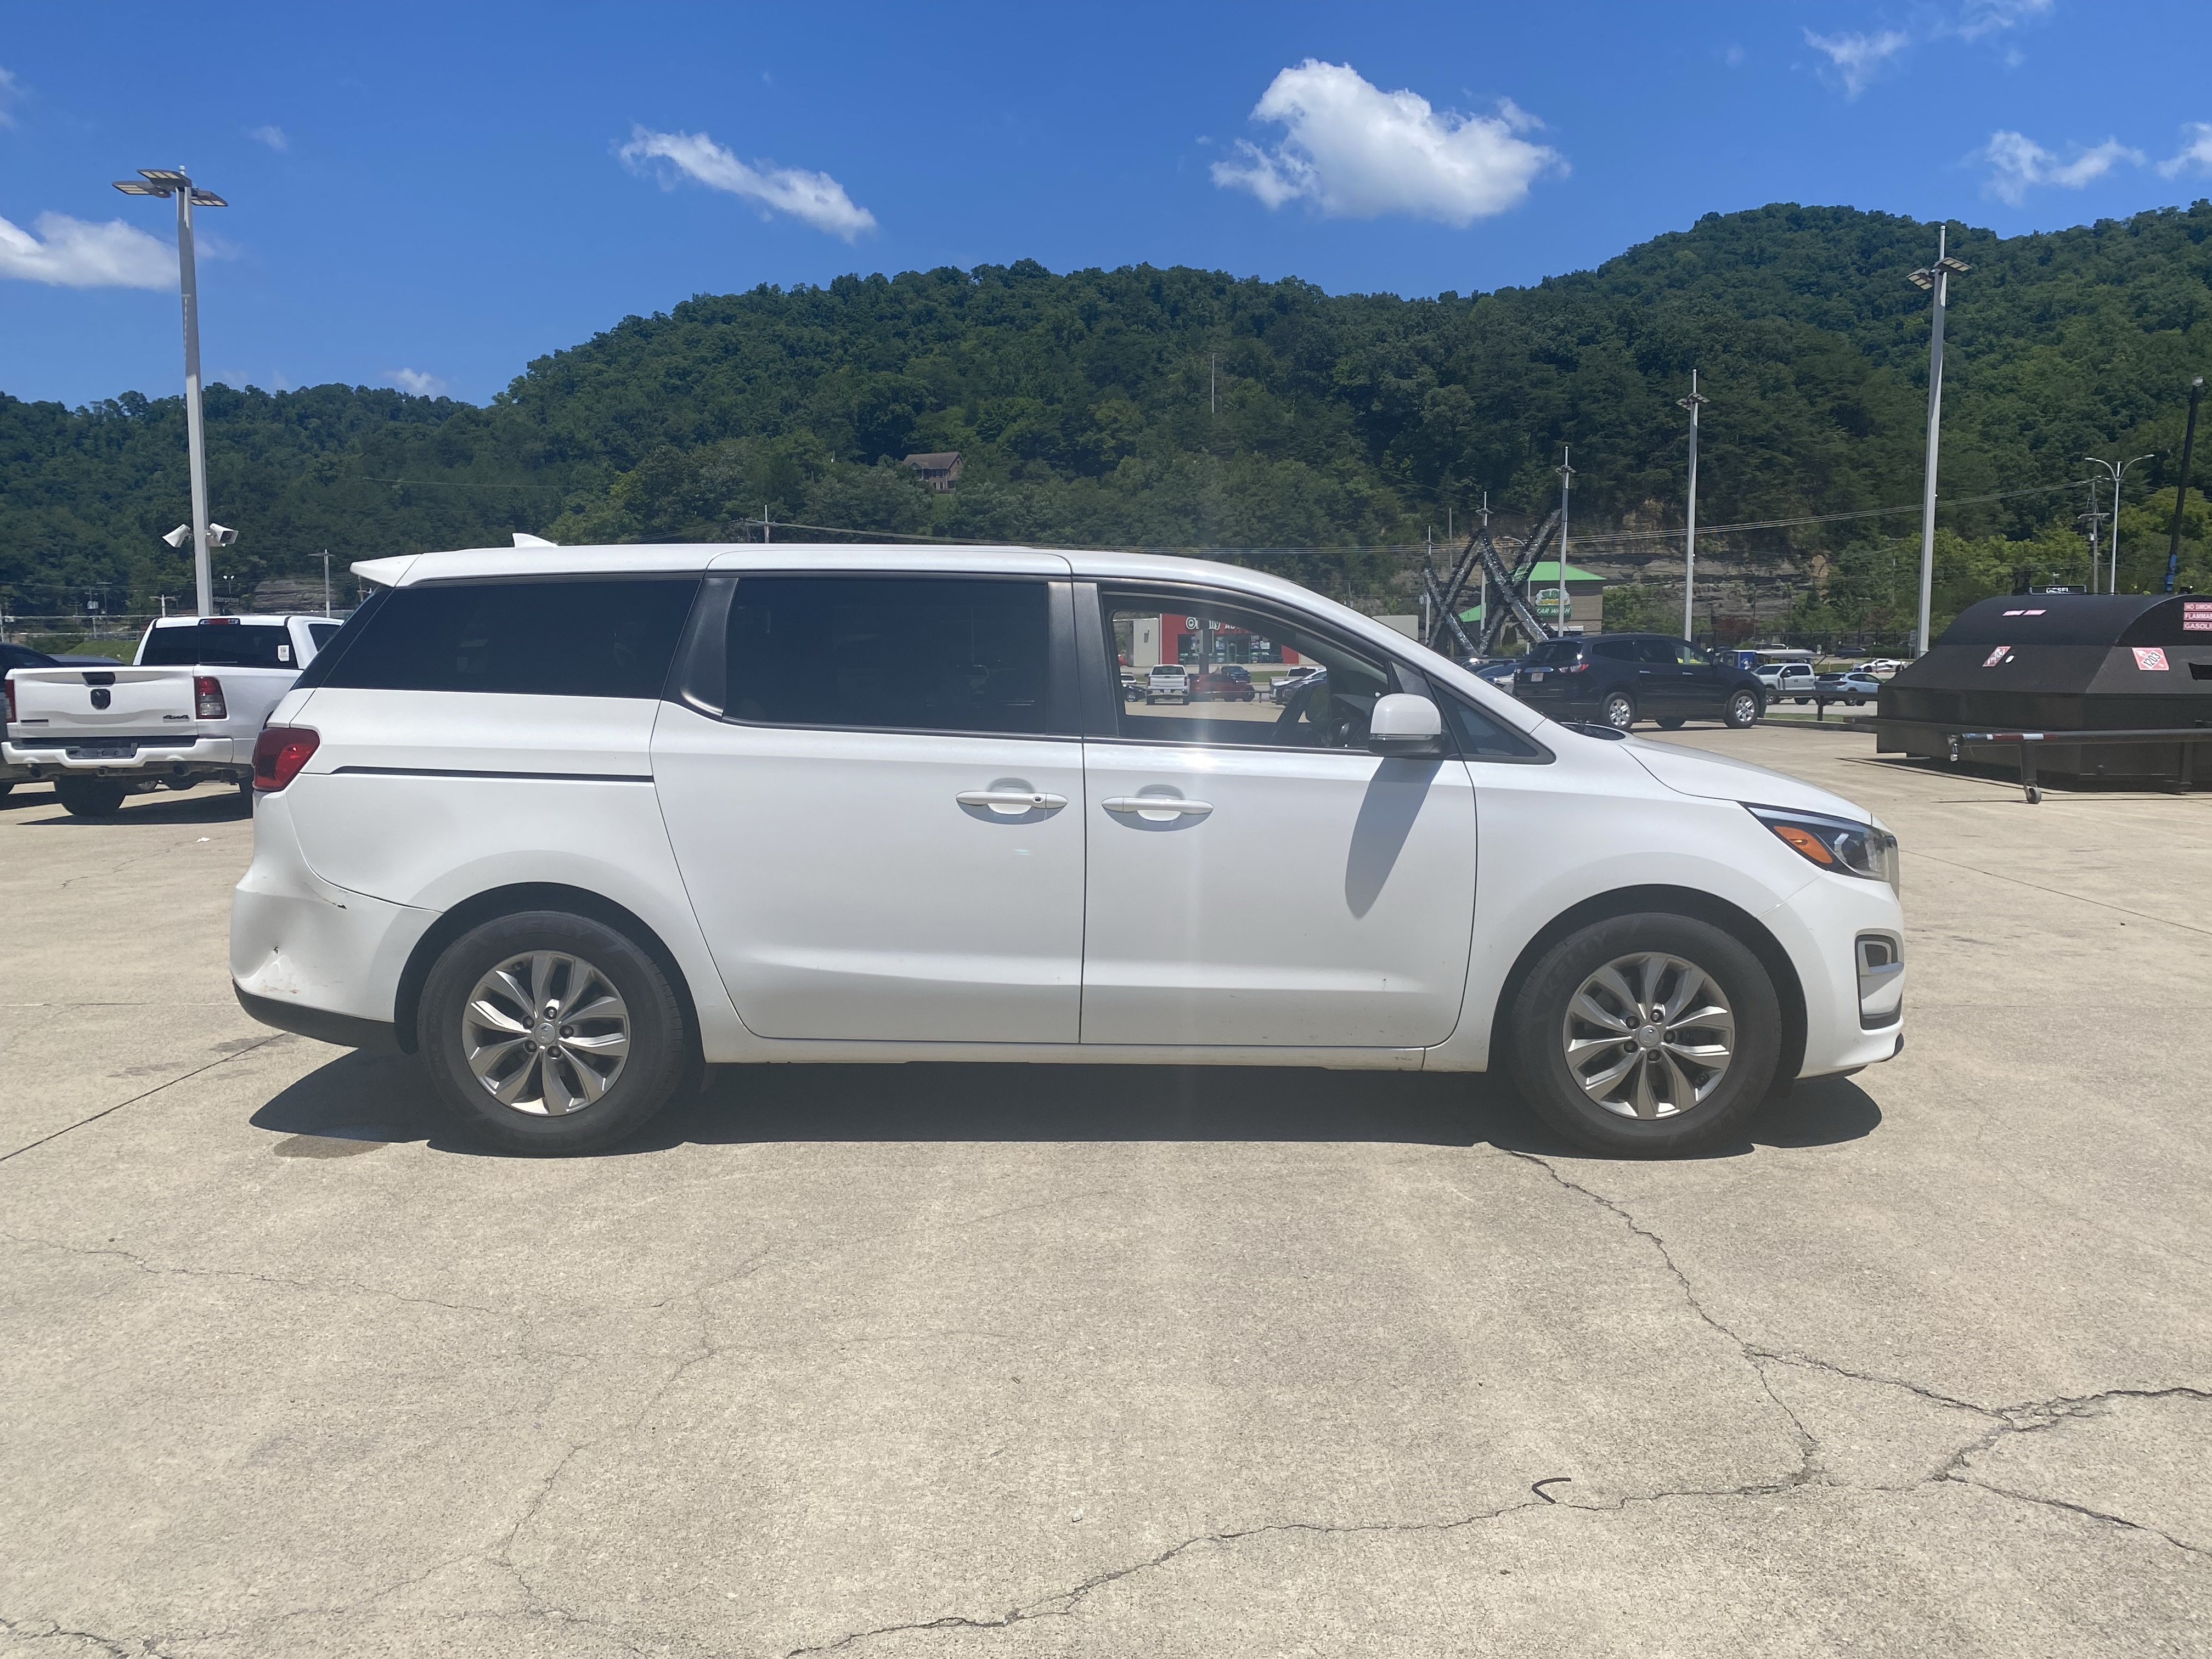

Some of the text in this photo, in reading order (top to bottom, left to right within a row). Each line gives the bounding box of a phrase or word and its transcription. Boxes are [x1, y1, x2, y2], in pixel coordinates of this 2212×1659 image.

[213, 596, 239, 604] nterprise
[2143, 652, 2161, 667] 1203
[1542, 931, 1607, 997] KELLY
